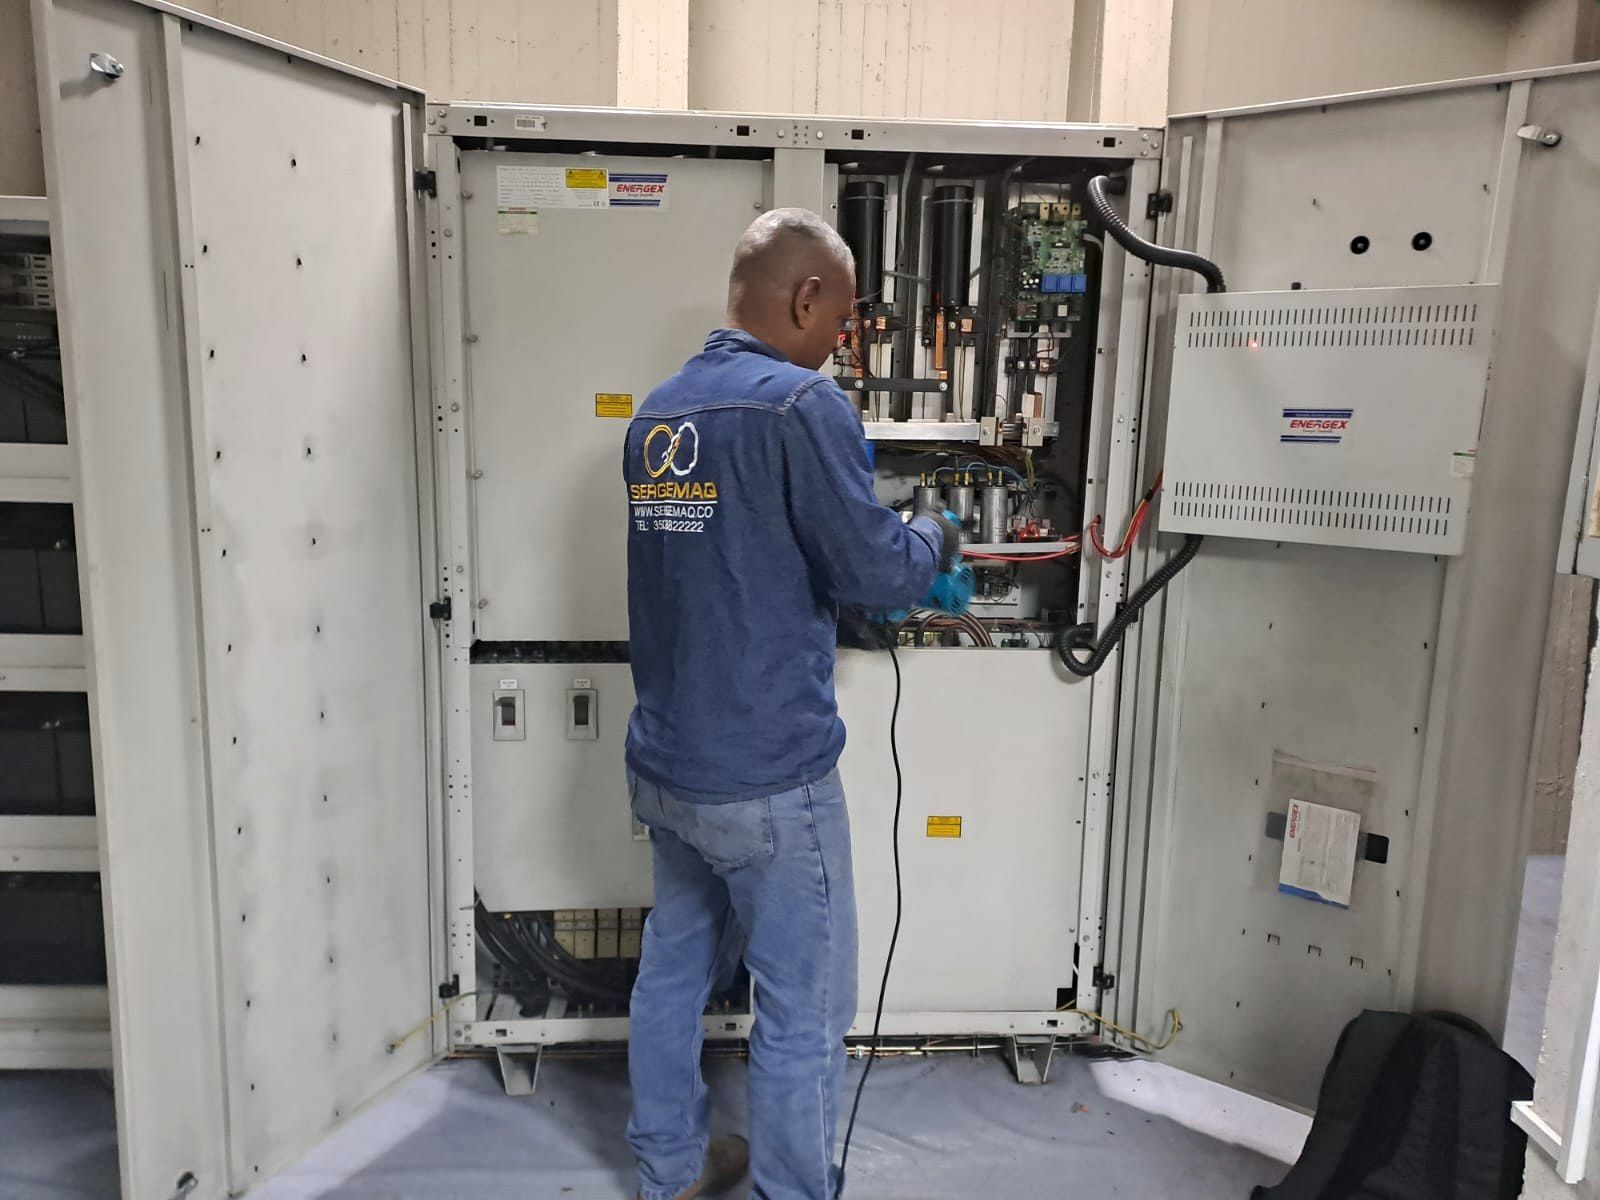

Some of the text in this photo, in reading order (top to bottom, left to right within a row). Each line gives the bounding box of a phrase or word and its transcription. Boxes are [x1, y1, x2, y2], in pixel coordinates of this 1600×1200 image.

[616, 184, 665, 193] ENERGEX
[1290, 420, 1349, 429] ENERGEX
[630, 482, 718, 499] SERGEMAQ
